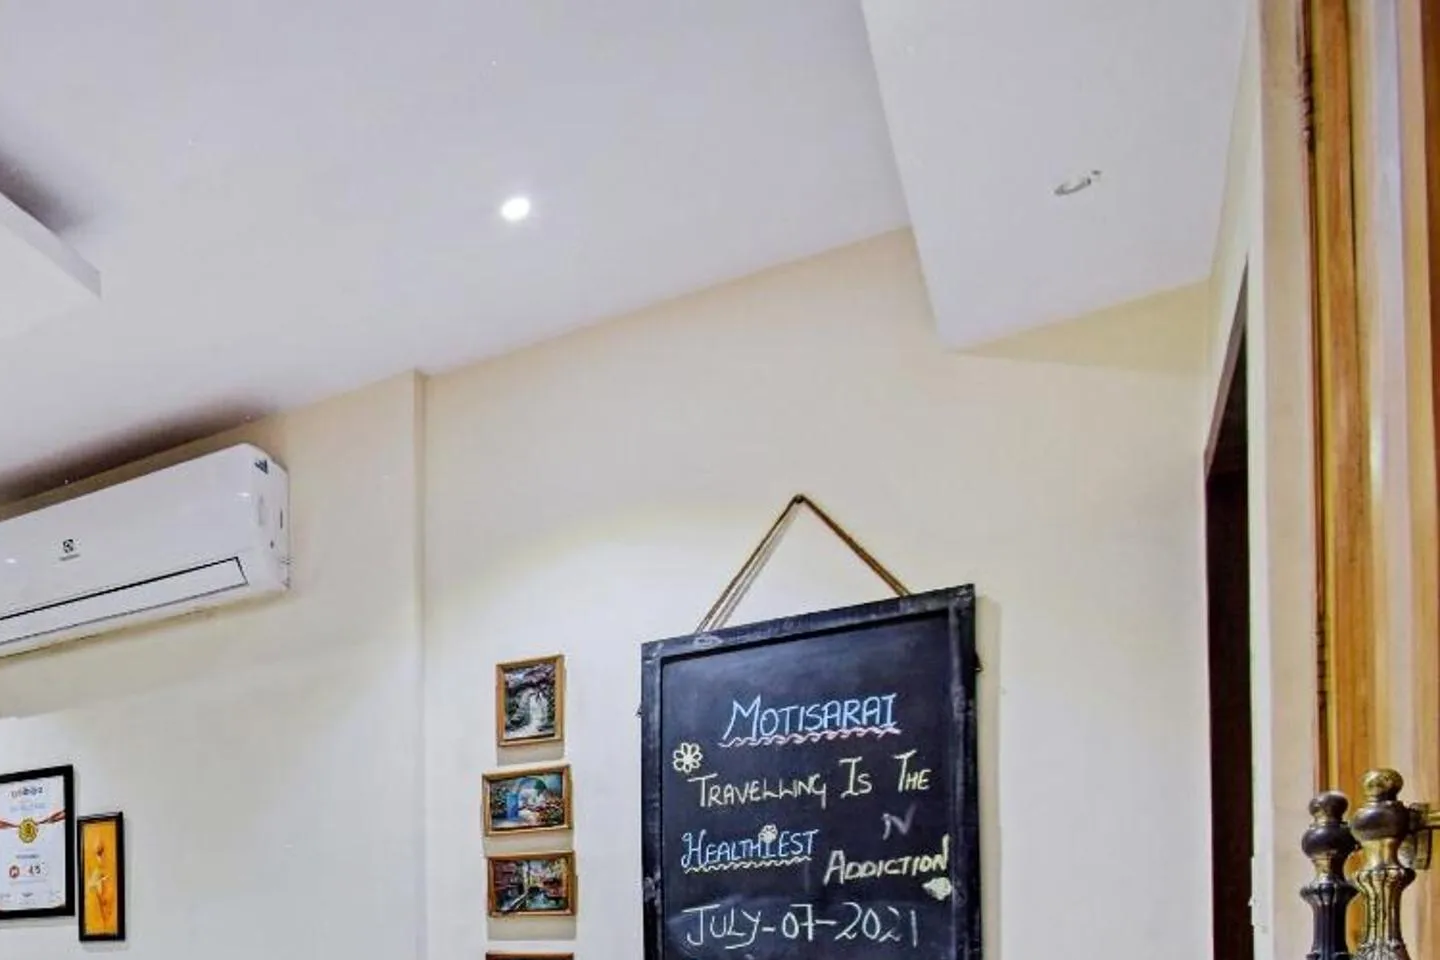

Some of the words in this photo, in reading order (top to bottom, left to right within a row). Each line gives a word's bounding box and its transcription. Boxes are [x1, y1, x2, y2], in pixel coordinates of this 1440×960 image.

[721, 692, 898, 742] MOTISARAI
[687, 772, 827, 810] TRAVELLING
[838, 755, 873, 799] IS
[893, 749, 932, 792] THE
[680, 829, 820, 869] HEALTHIEST
